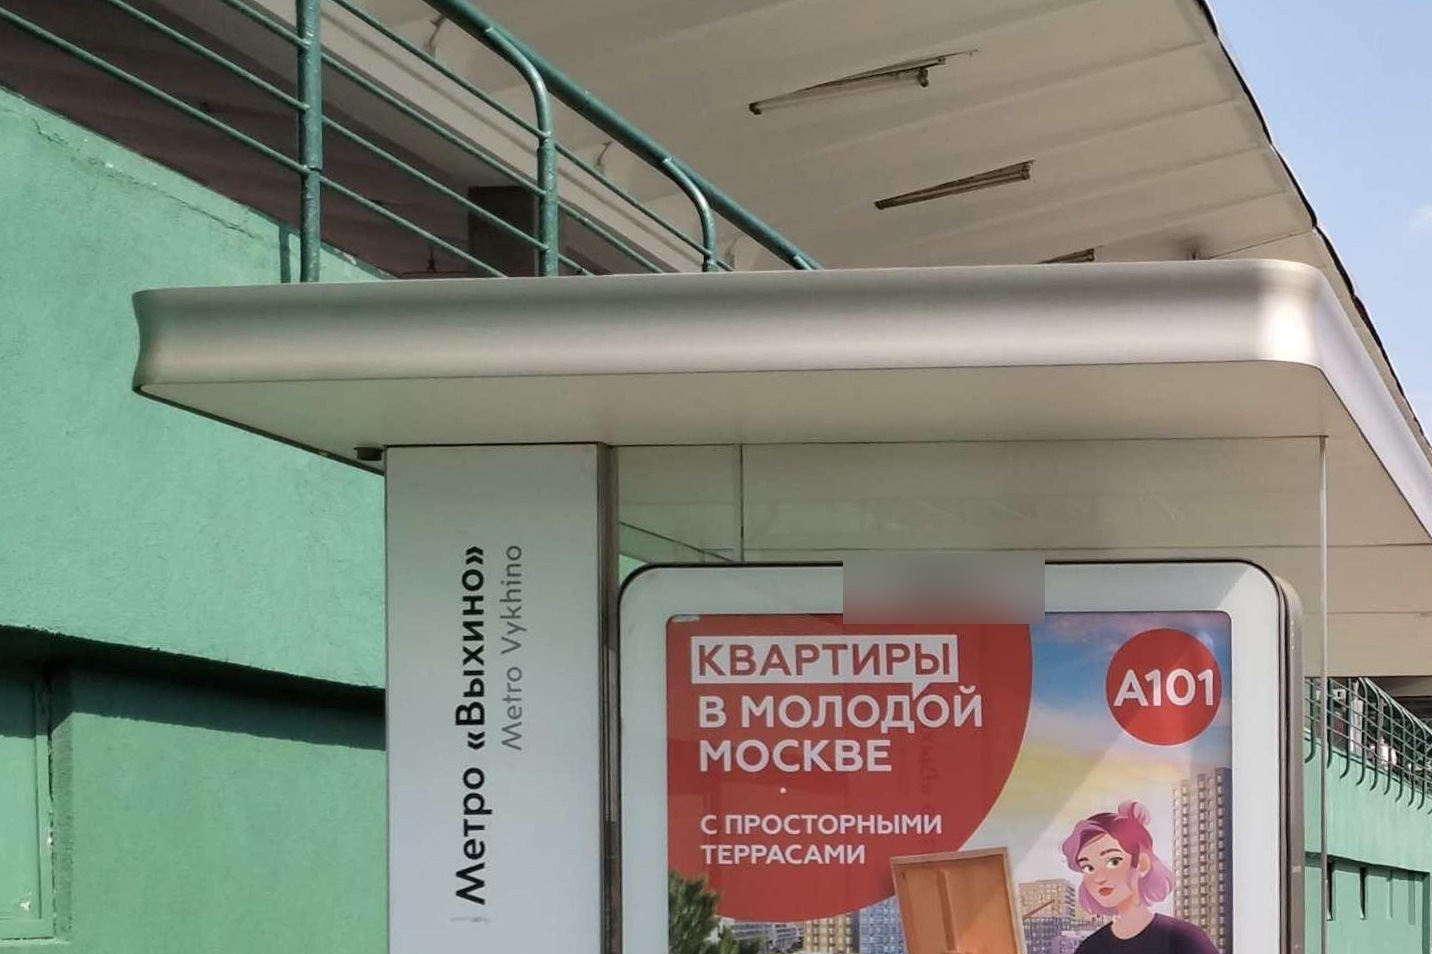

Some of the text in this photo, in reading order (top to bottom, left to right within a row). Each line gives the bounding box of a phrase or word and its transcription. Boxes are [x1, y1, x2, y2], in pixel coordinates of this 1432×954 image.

[500, 544, 527, 751] Metro Vykhino
[698, 643, 951, 677] КВАРТИРЫ
[455, 545, 493, 905] Метро «Выхино»
[699, 685, 984, 733] В МОЛОДОЙ
[699, 738, 893, 773] МОСКВЕ
[701, 814, 942, 835] С ПРОСТОРНЫМИ
[701, 843, 866, 865] ТЕРРАСАМИ
